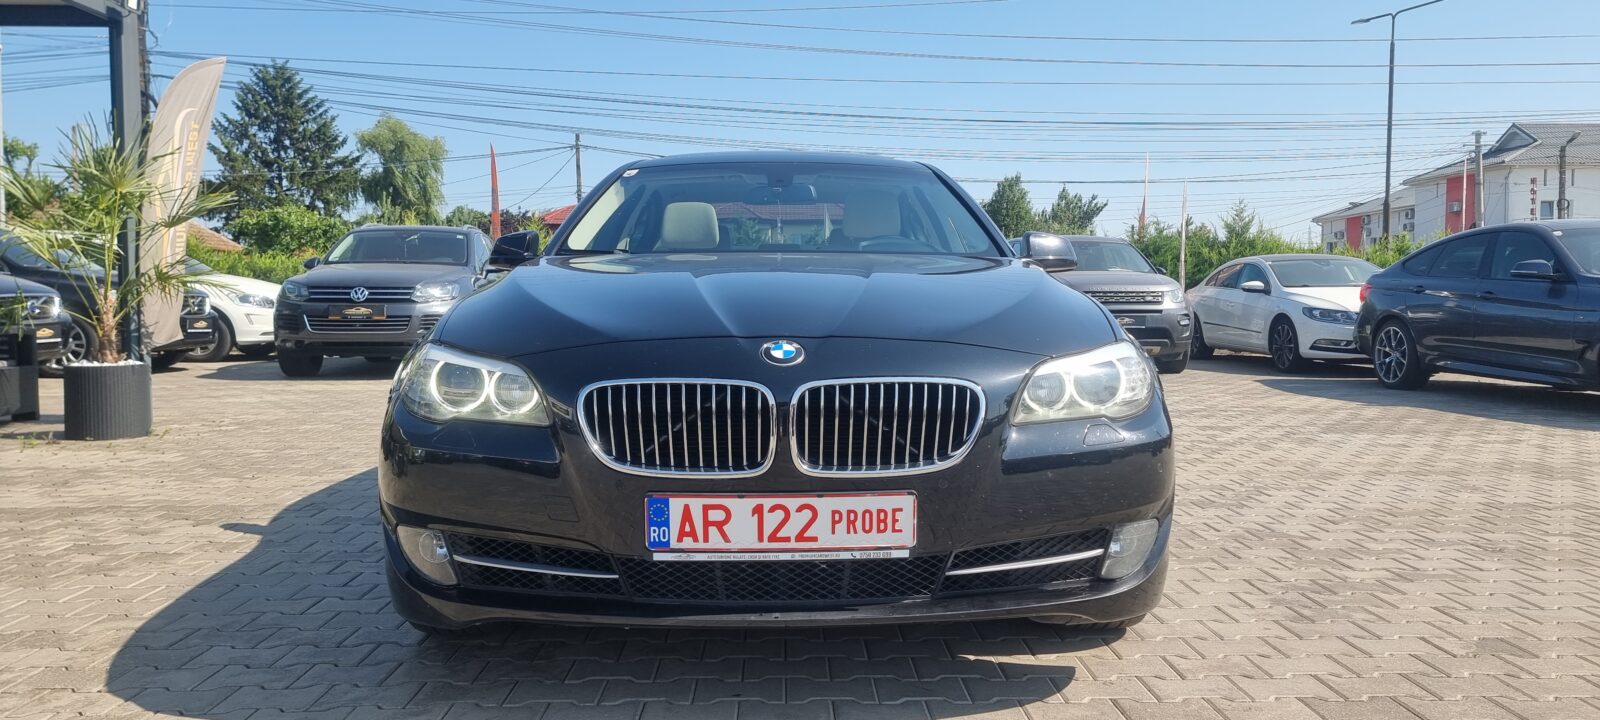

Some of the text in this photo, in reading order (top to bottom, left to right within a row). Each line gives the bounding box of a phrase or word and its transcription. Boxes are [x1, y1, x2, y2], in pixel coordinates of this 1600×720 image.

[185, 120, 200, 166] WEST
[650, 526, 669, 542] RO
[676, 503, 904, 543] AR 122 PROBE
